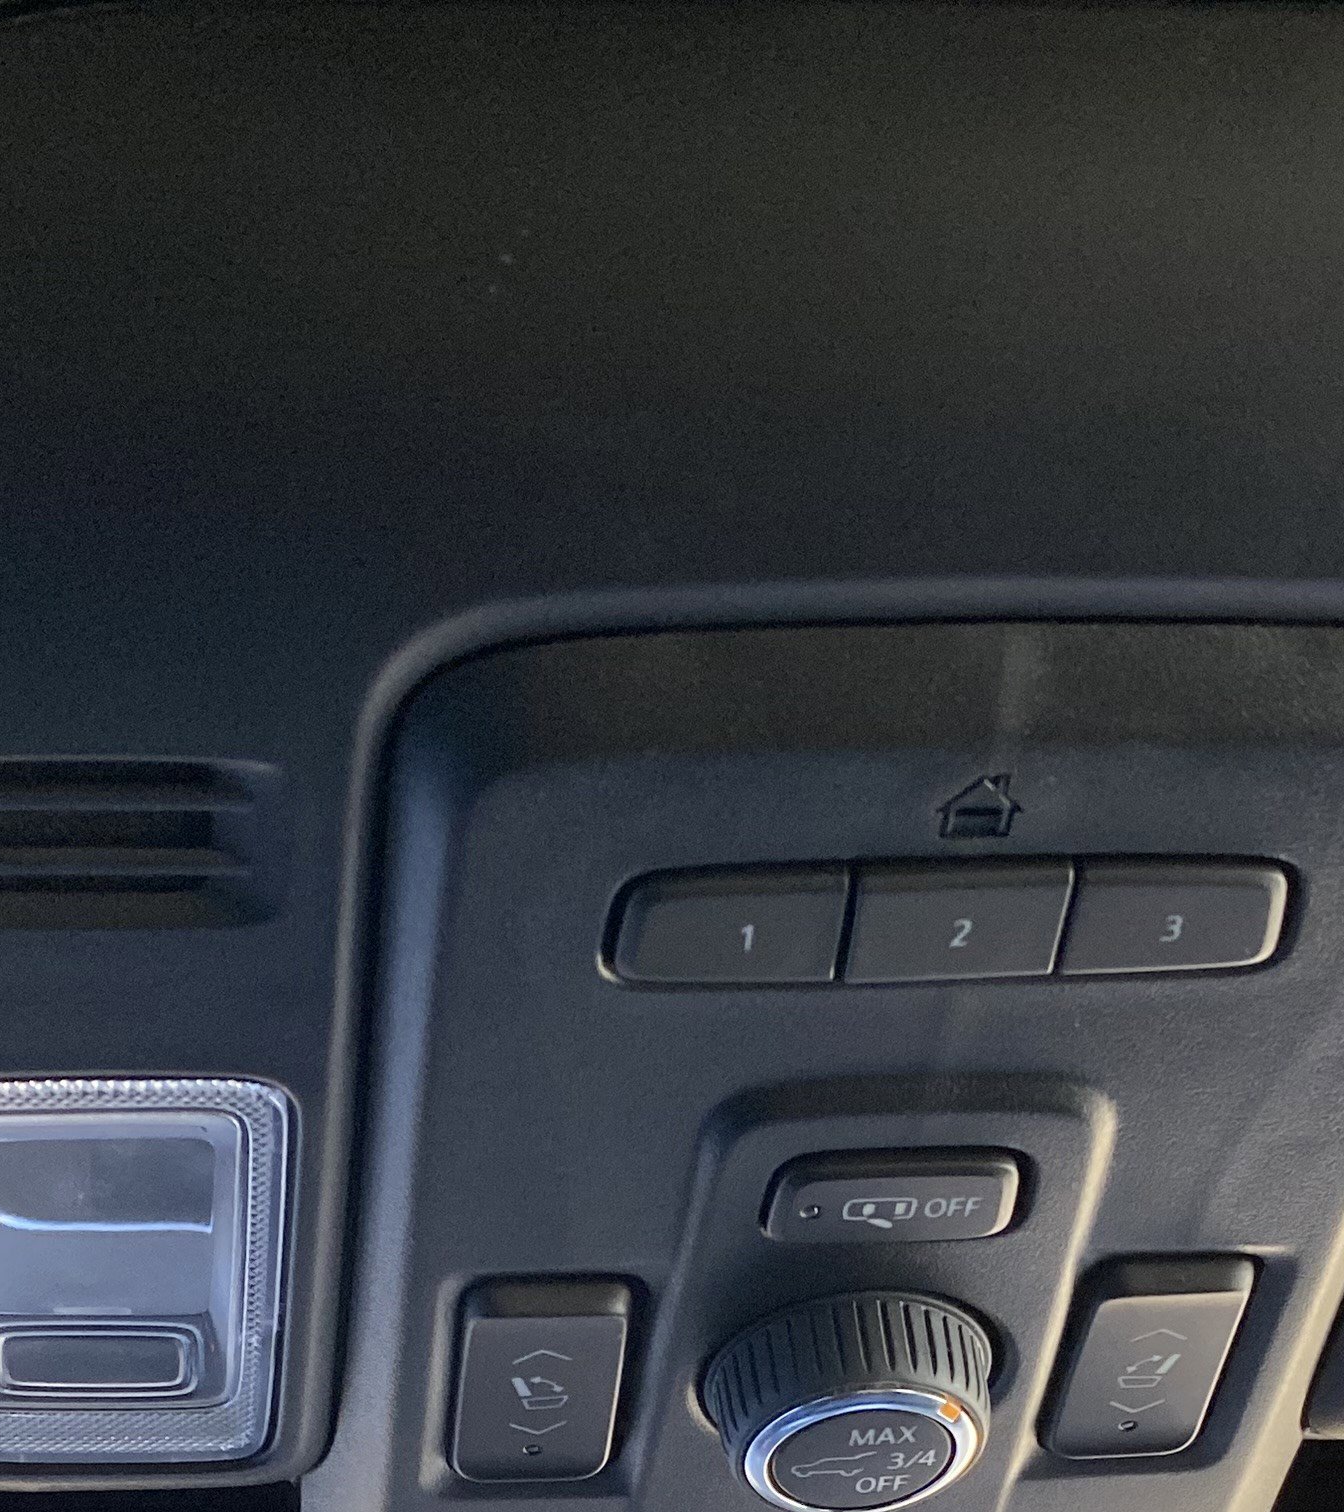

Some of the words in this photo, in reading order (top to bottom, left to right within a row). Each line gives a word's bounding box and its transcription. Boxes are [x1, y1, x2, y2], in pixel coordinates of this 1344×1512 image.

[741, 923, 755, 952] 1
[949, 918, 972, 949] 2
[1159, 914, 1183, 942] 3
[923, 1197, 983, 1218] OFF
[848, 1425, 918, 1447] MAX
[886, 1449, 937, 1470] 3/4
[855, 1474, 912, 1494] OFF
